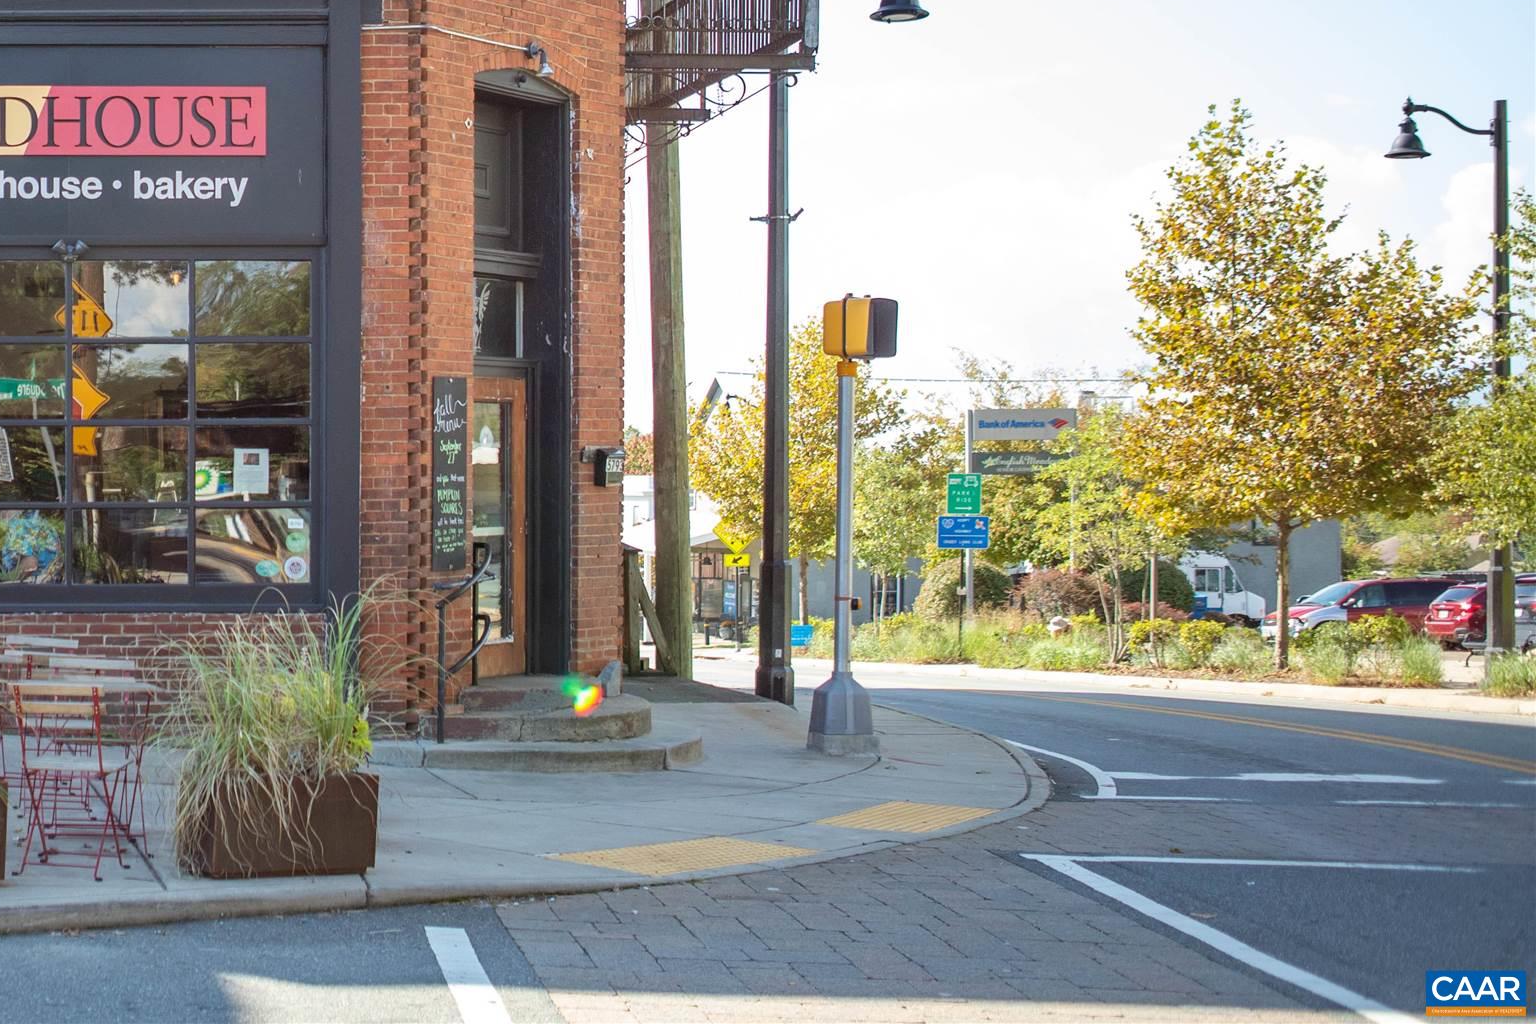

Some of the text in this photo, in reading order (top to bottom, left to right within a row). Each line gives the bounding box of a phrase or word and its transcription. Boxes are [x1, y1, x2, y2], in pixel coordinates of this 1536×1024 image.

[133, 171, 249, 207] bakery
[978, 419, 1045, 429] Bank of America
[992, 455, 1024, 468] English
